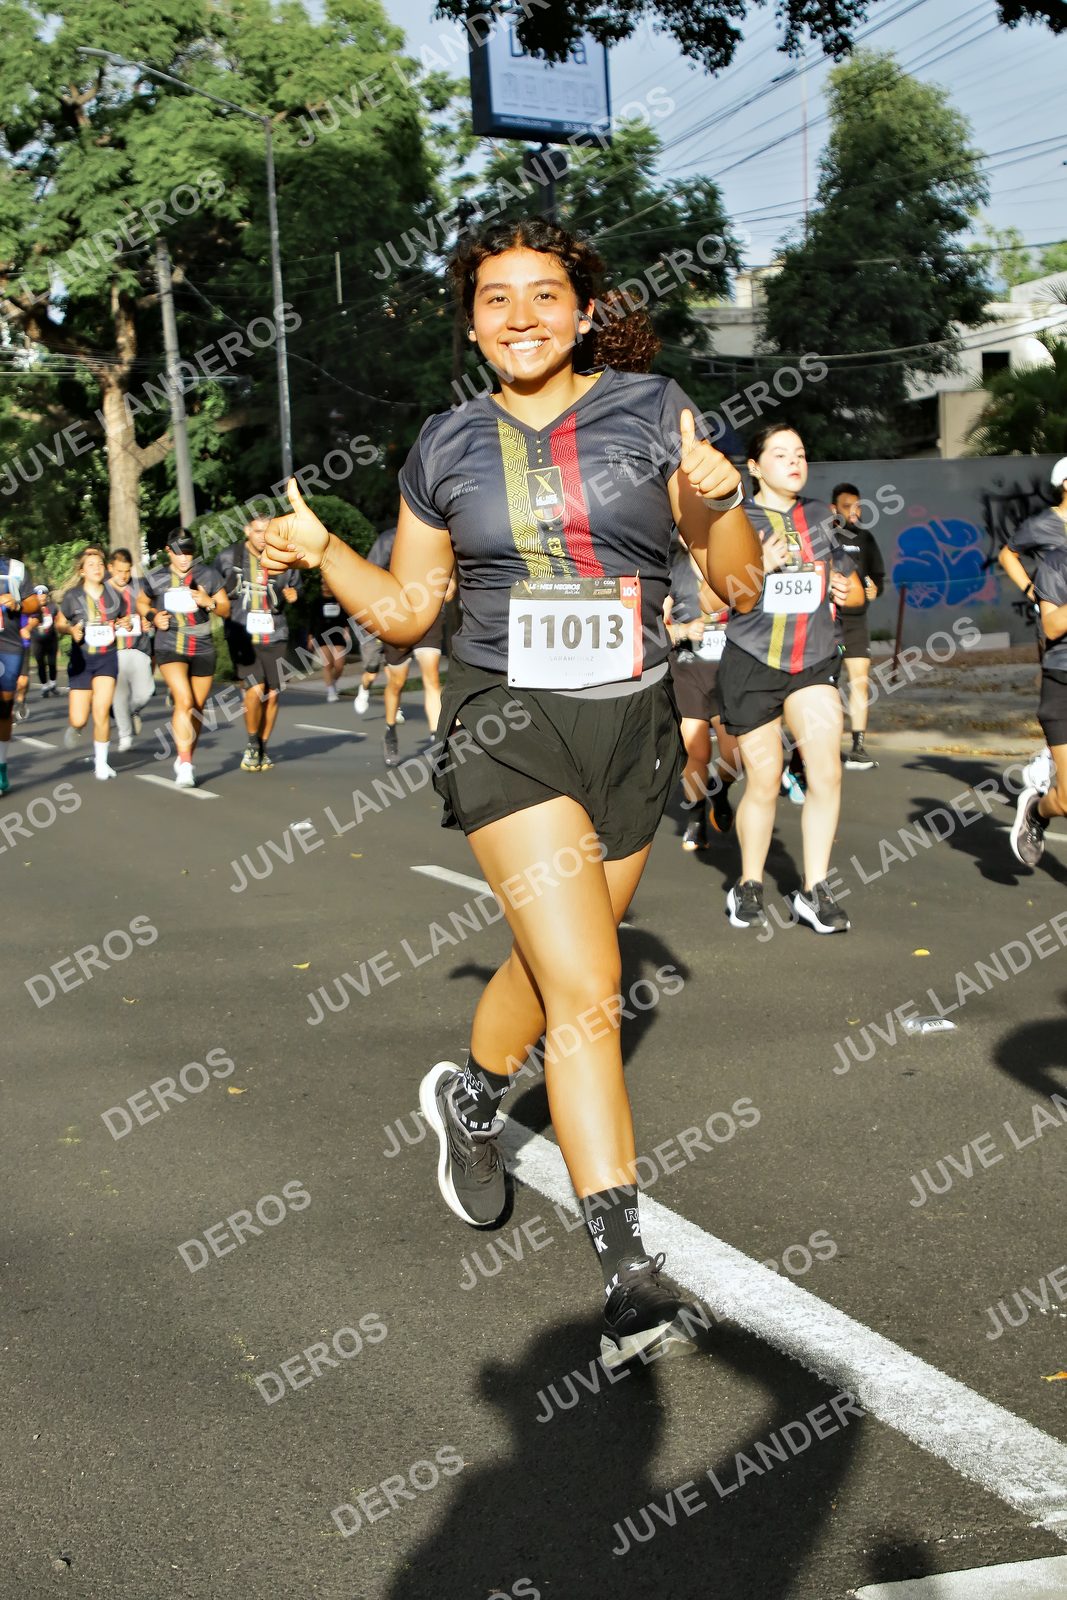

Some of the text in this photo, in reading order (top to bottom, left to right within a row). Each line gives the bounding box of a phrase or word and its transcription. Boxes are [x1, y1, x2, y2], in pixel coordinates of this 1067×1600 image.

[622, 586, 638, 597] 10K
[774, 579, 812, 596] 9584
[517, 614, 624, 650] 11013
